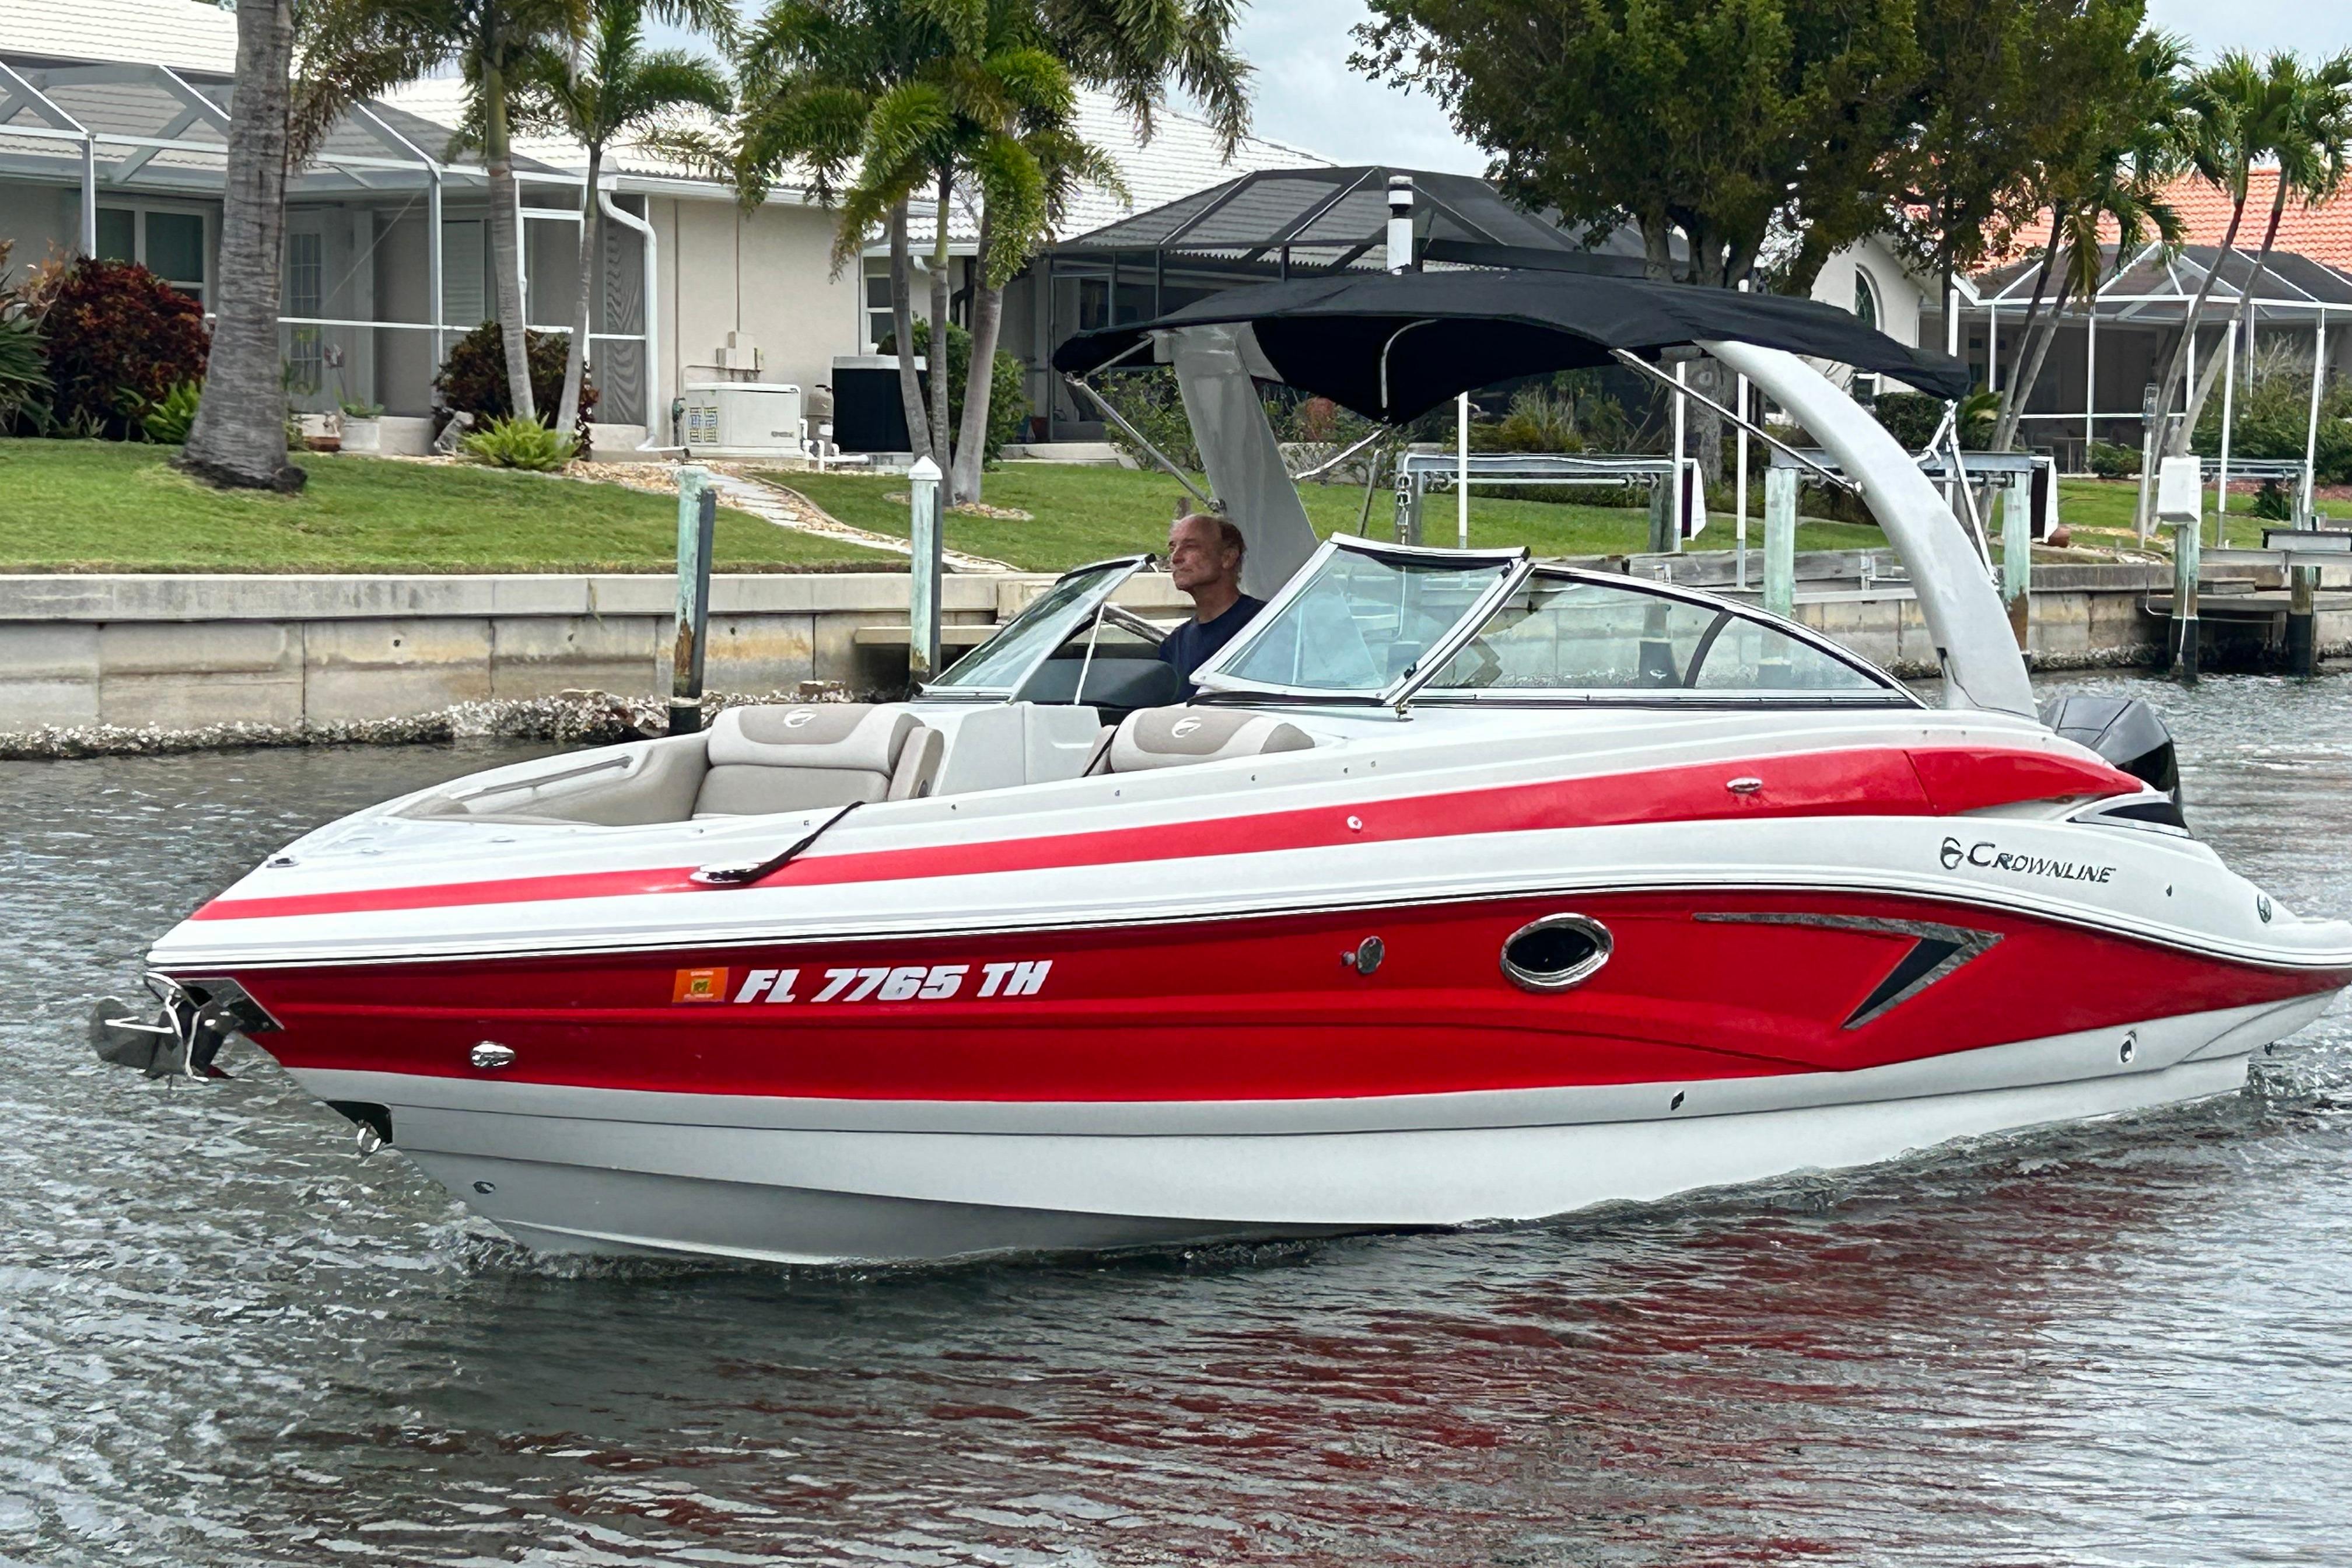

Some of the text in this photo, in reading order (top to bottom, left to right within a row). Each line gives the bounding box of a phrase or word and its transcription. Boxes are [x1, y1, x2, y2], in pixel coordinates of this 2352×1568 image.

[1967, 841, 2116, 883] CROWNLINE
[734, 960, 1053, 1003] FL 7765 TH
